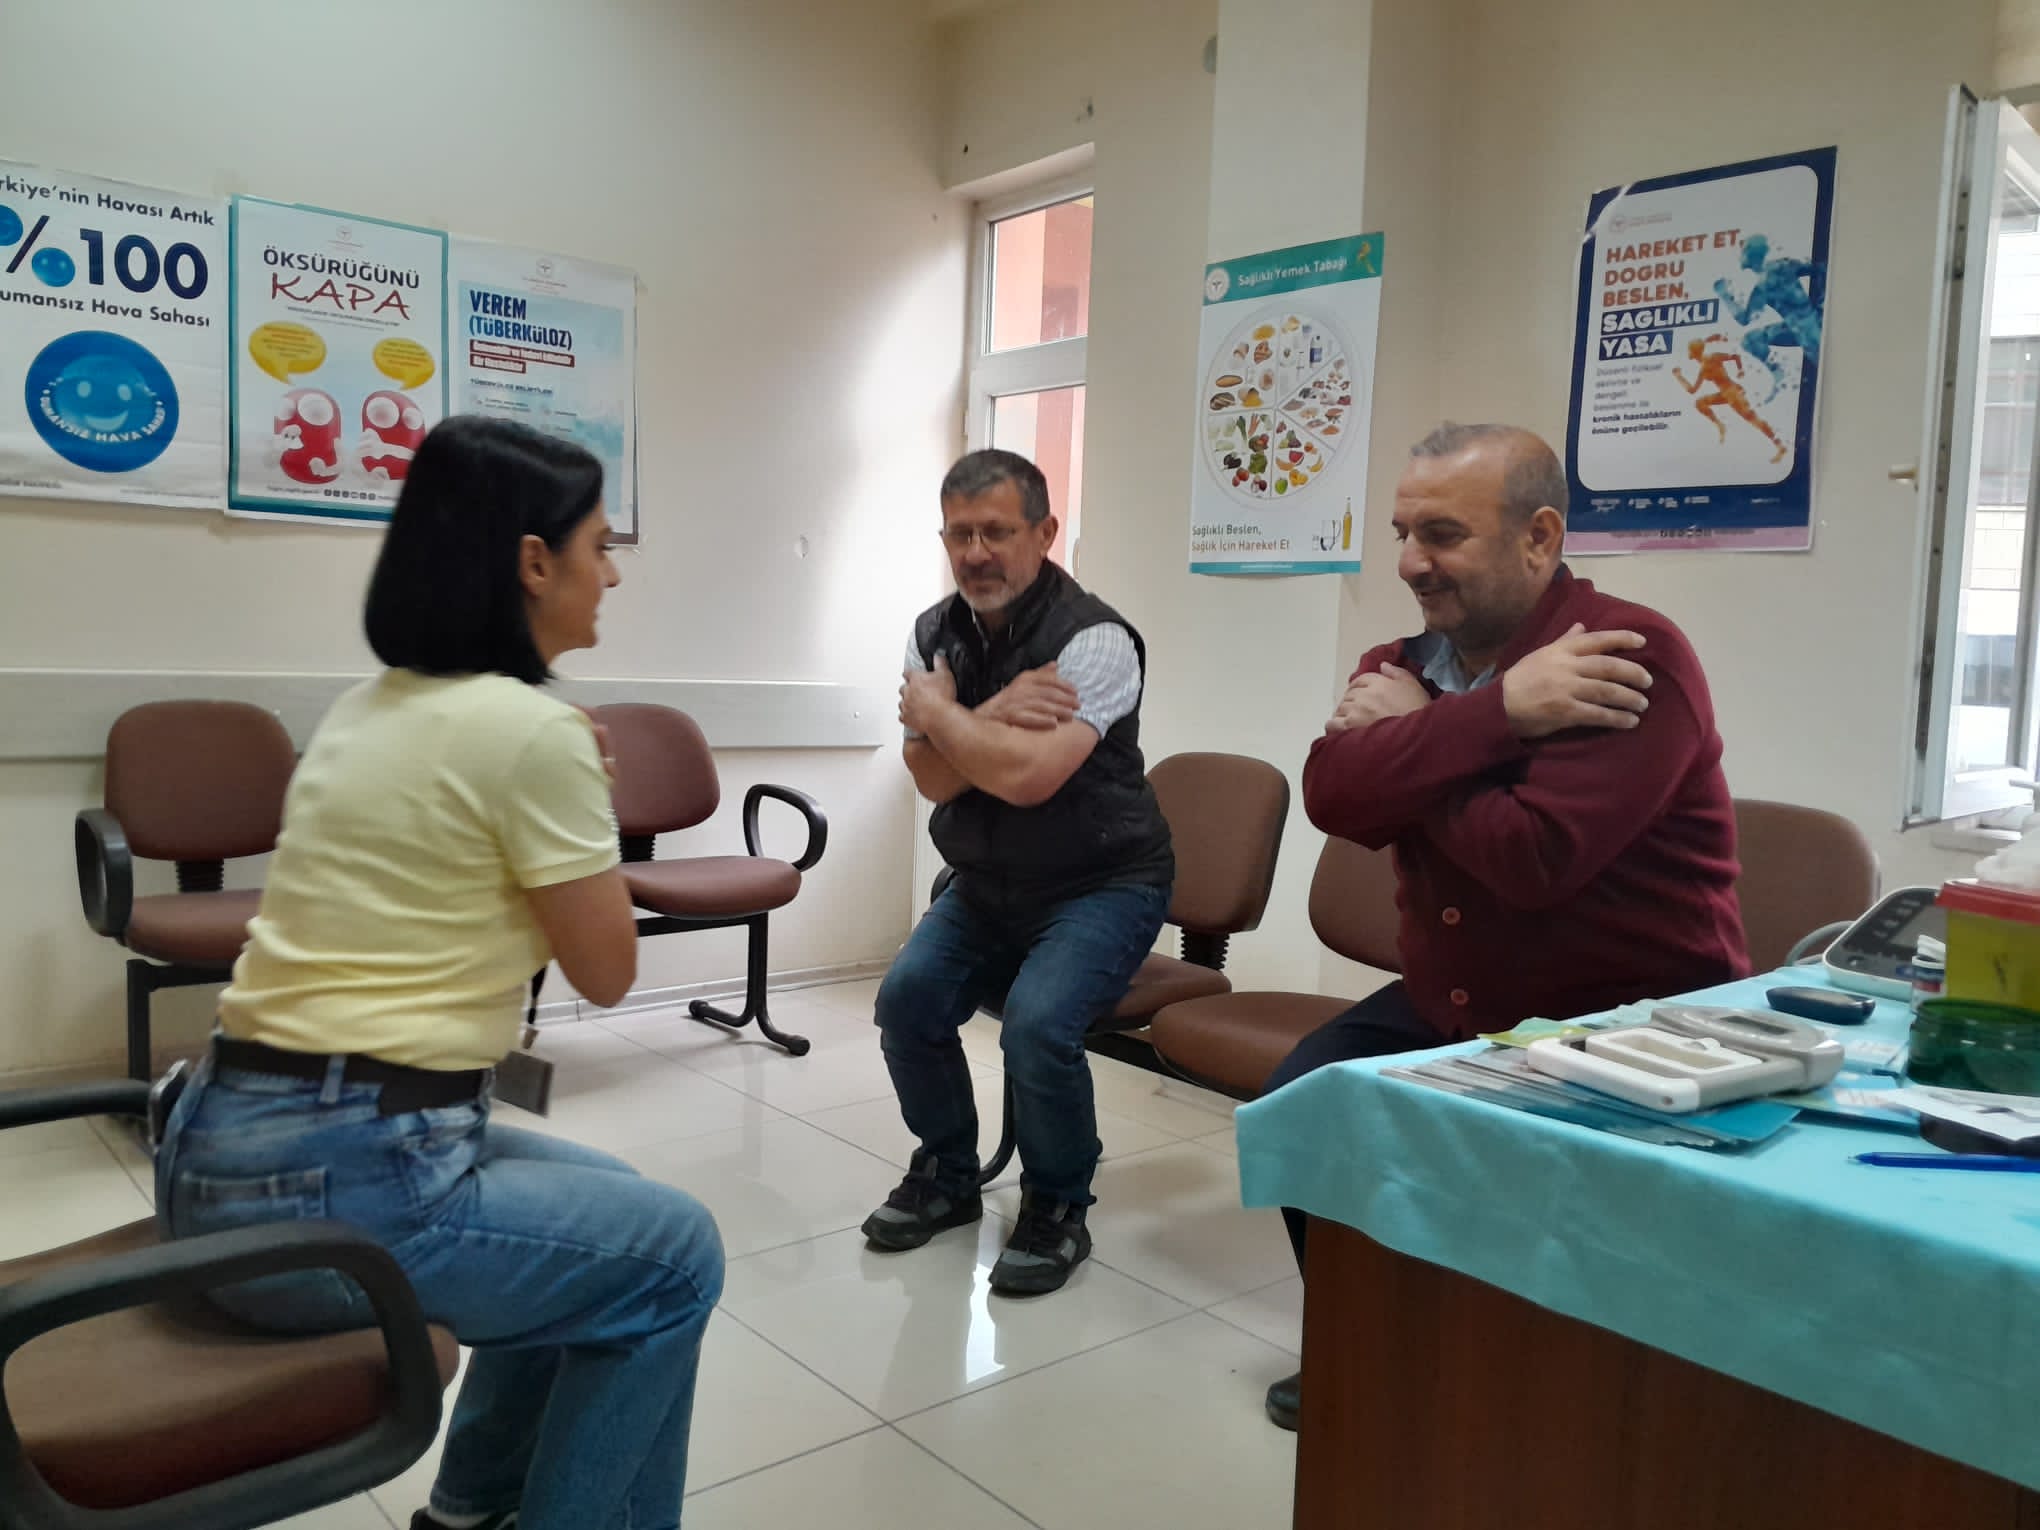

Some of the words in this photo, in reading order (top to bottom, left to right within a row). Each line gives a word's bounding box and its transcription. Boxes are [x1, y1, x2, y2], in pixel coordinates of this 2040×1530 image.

[0, 175, 89, 205] rkiye'nin
[97, 194, 162, 217] Havası
[170, 207, 214, 226] Artık
[1606, 234, 1707, 264] HAREKET
[263, 245, 420, 288] ÖKSÜRÜĞÜNÜ
[1275, 264, 1310, 279] Yemek
[0, 290, 84, 311] umansız
[92, 299, 142, 318] Hava
[150, 307, 209, 327] Sahası
[272, 272, 410, 320] KAPA
[470, 290, 527, 320] VEREM
[1603, 281, 1688, 307] BESLEN,
[469, 315, 572, 351] (TÜBERKÜLOZ)
[1226, 524, 1262, 536] Beslen,
